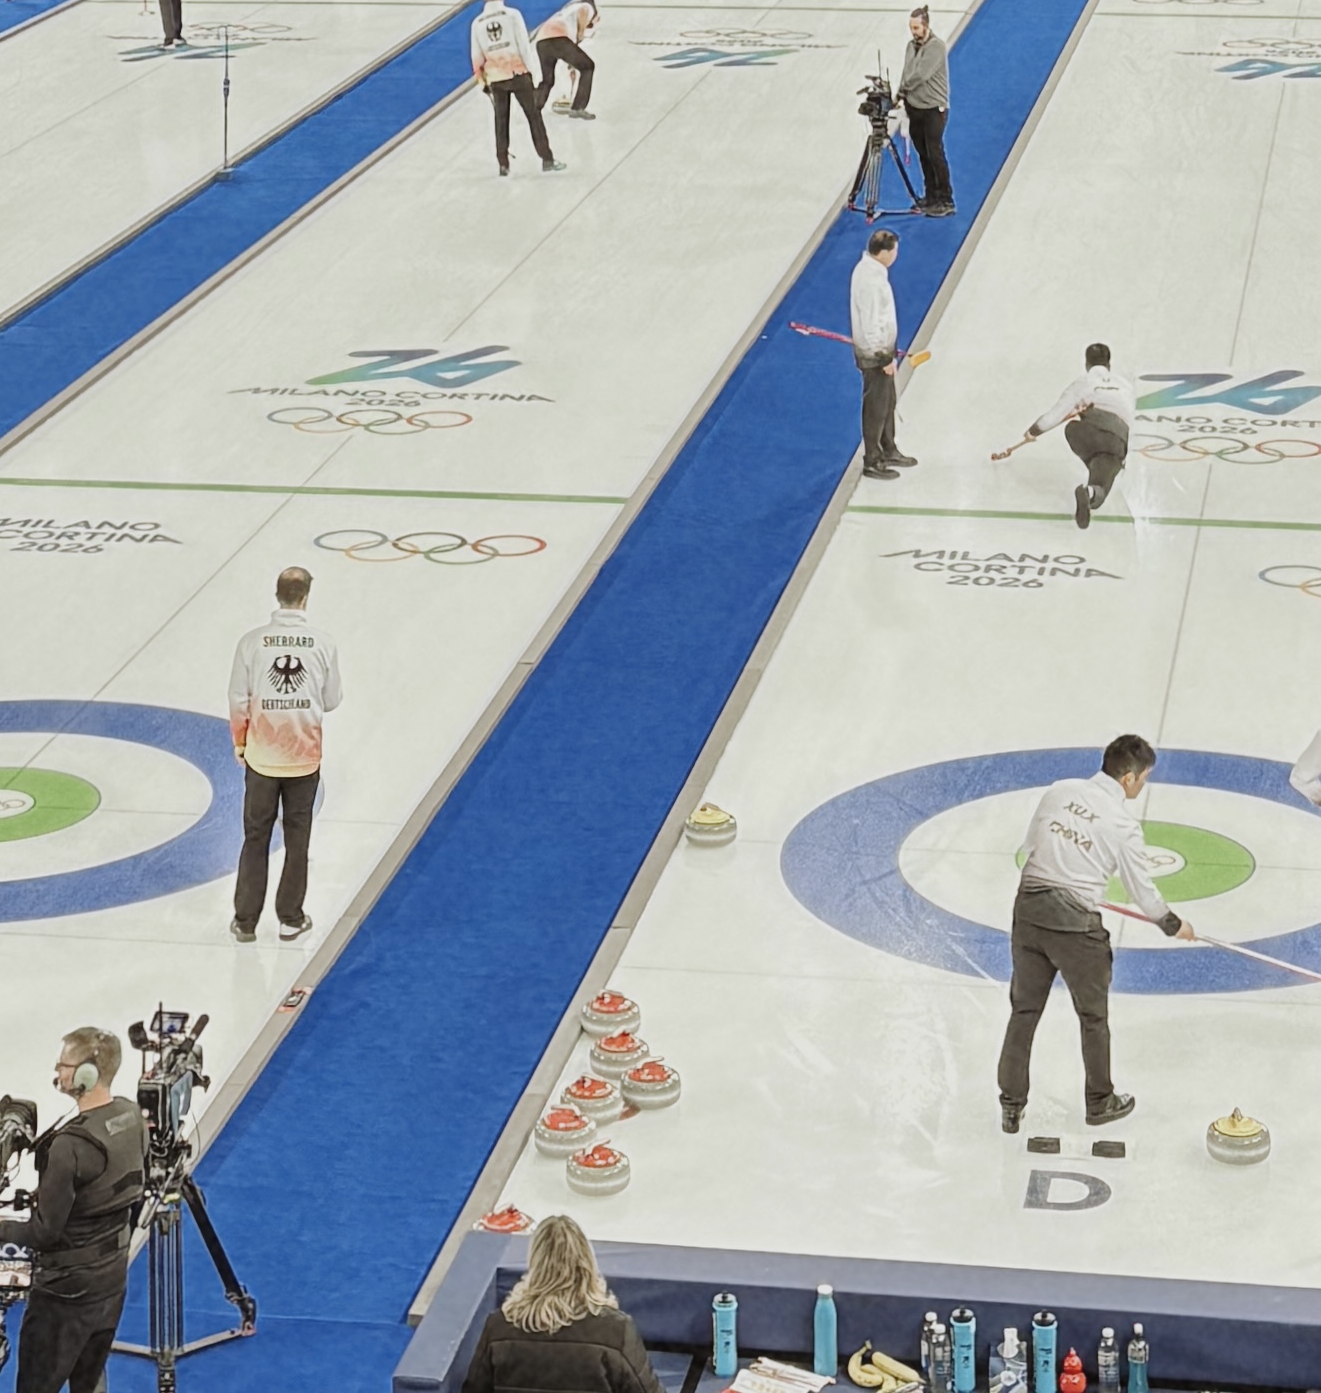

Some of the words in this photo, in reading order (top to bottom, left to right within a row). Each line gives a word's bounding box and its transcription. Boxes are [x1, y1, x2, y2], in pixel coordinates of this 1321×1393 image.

[227, 386, 387, 399] MILANO
[394, 389, 556, 403] CORTINA
[344, 397, 422, 408] 2026
[1177, 423, 1259, 435] 2026
[9, 541, 105, 554] 2026
[878, 548, 1087, 565] MILANO
[913, 561, 1126, 580] CORTINA
[945, 575, 1045, 589] 2026
[1022, 1169, 1112, 1212] D
